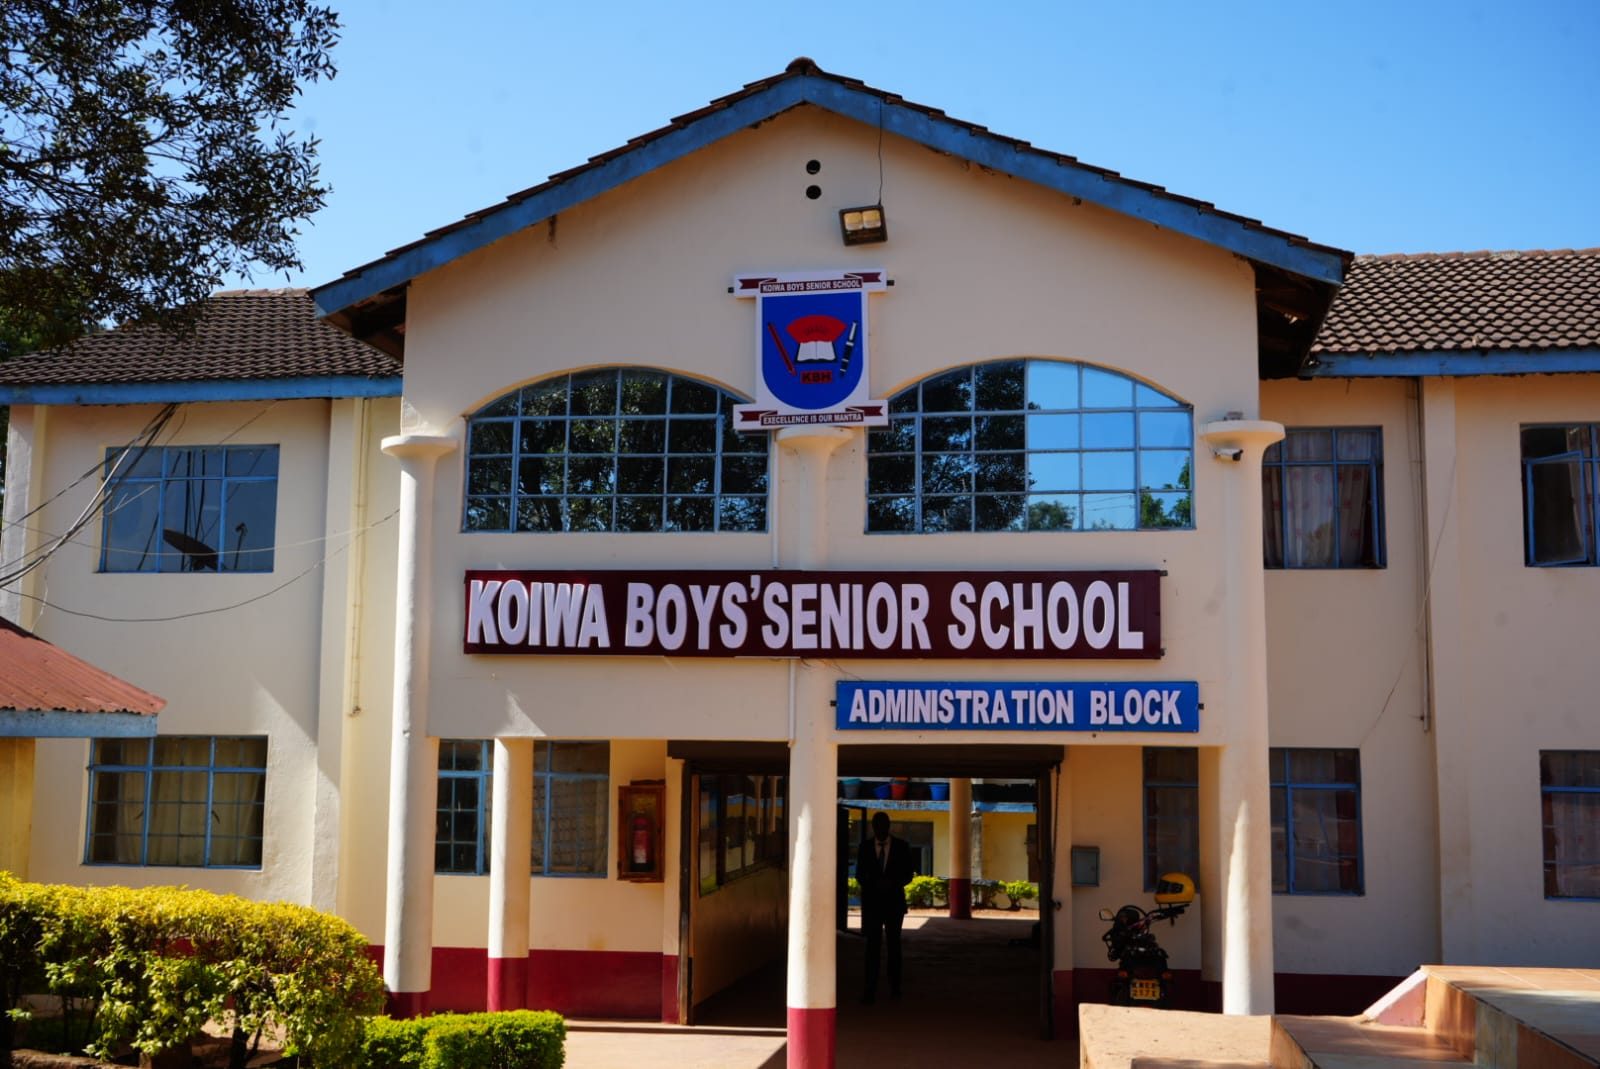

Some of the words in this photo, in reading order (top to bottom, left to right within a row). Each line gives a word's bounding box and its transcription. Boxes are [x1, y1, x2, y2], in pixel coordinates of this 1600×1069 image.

[763, 284, 785, 292] KOIWA
[787, 282, 804, 291] BOYS
[806, 281, 831, 290] SENIOR
[832, 279, 861, 289] SCHOOL
[803, 372, 831, 382] KBH
[763, 415, 809, 424] EXECELLENCE
[811, 415, 817, 423] IS
[819, 414, 832, 423] OUR
[834, 413, 861, 422] MANTRA
[467, 579, 610, 648] KOIWA
[762, 581, 931, 650] SENIOR
[948, 581, 1143, 650] SCHOOL
[849, 689, 1074, 724] ADMINISTRATION
[1090, 690, 1182, 725] BLOCK
